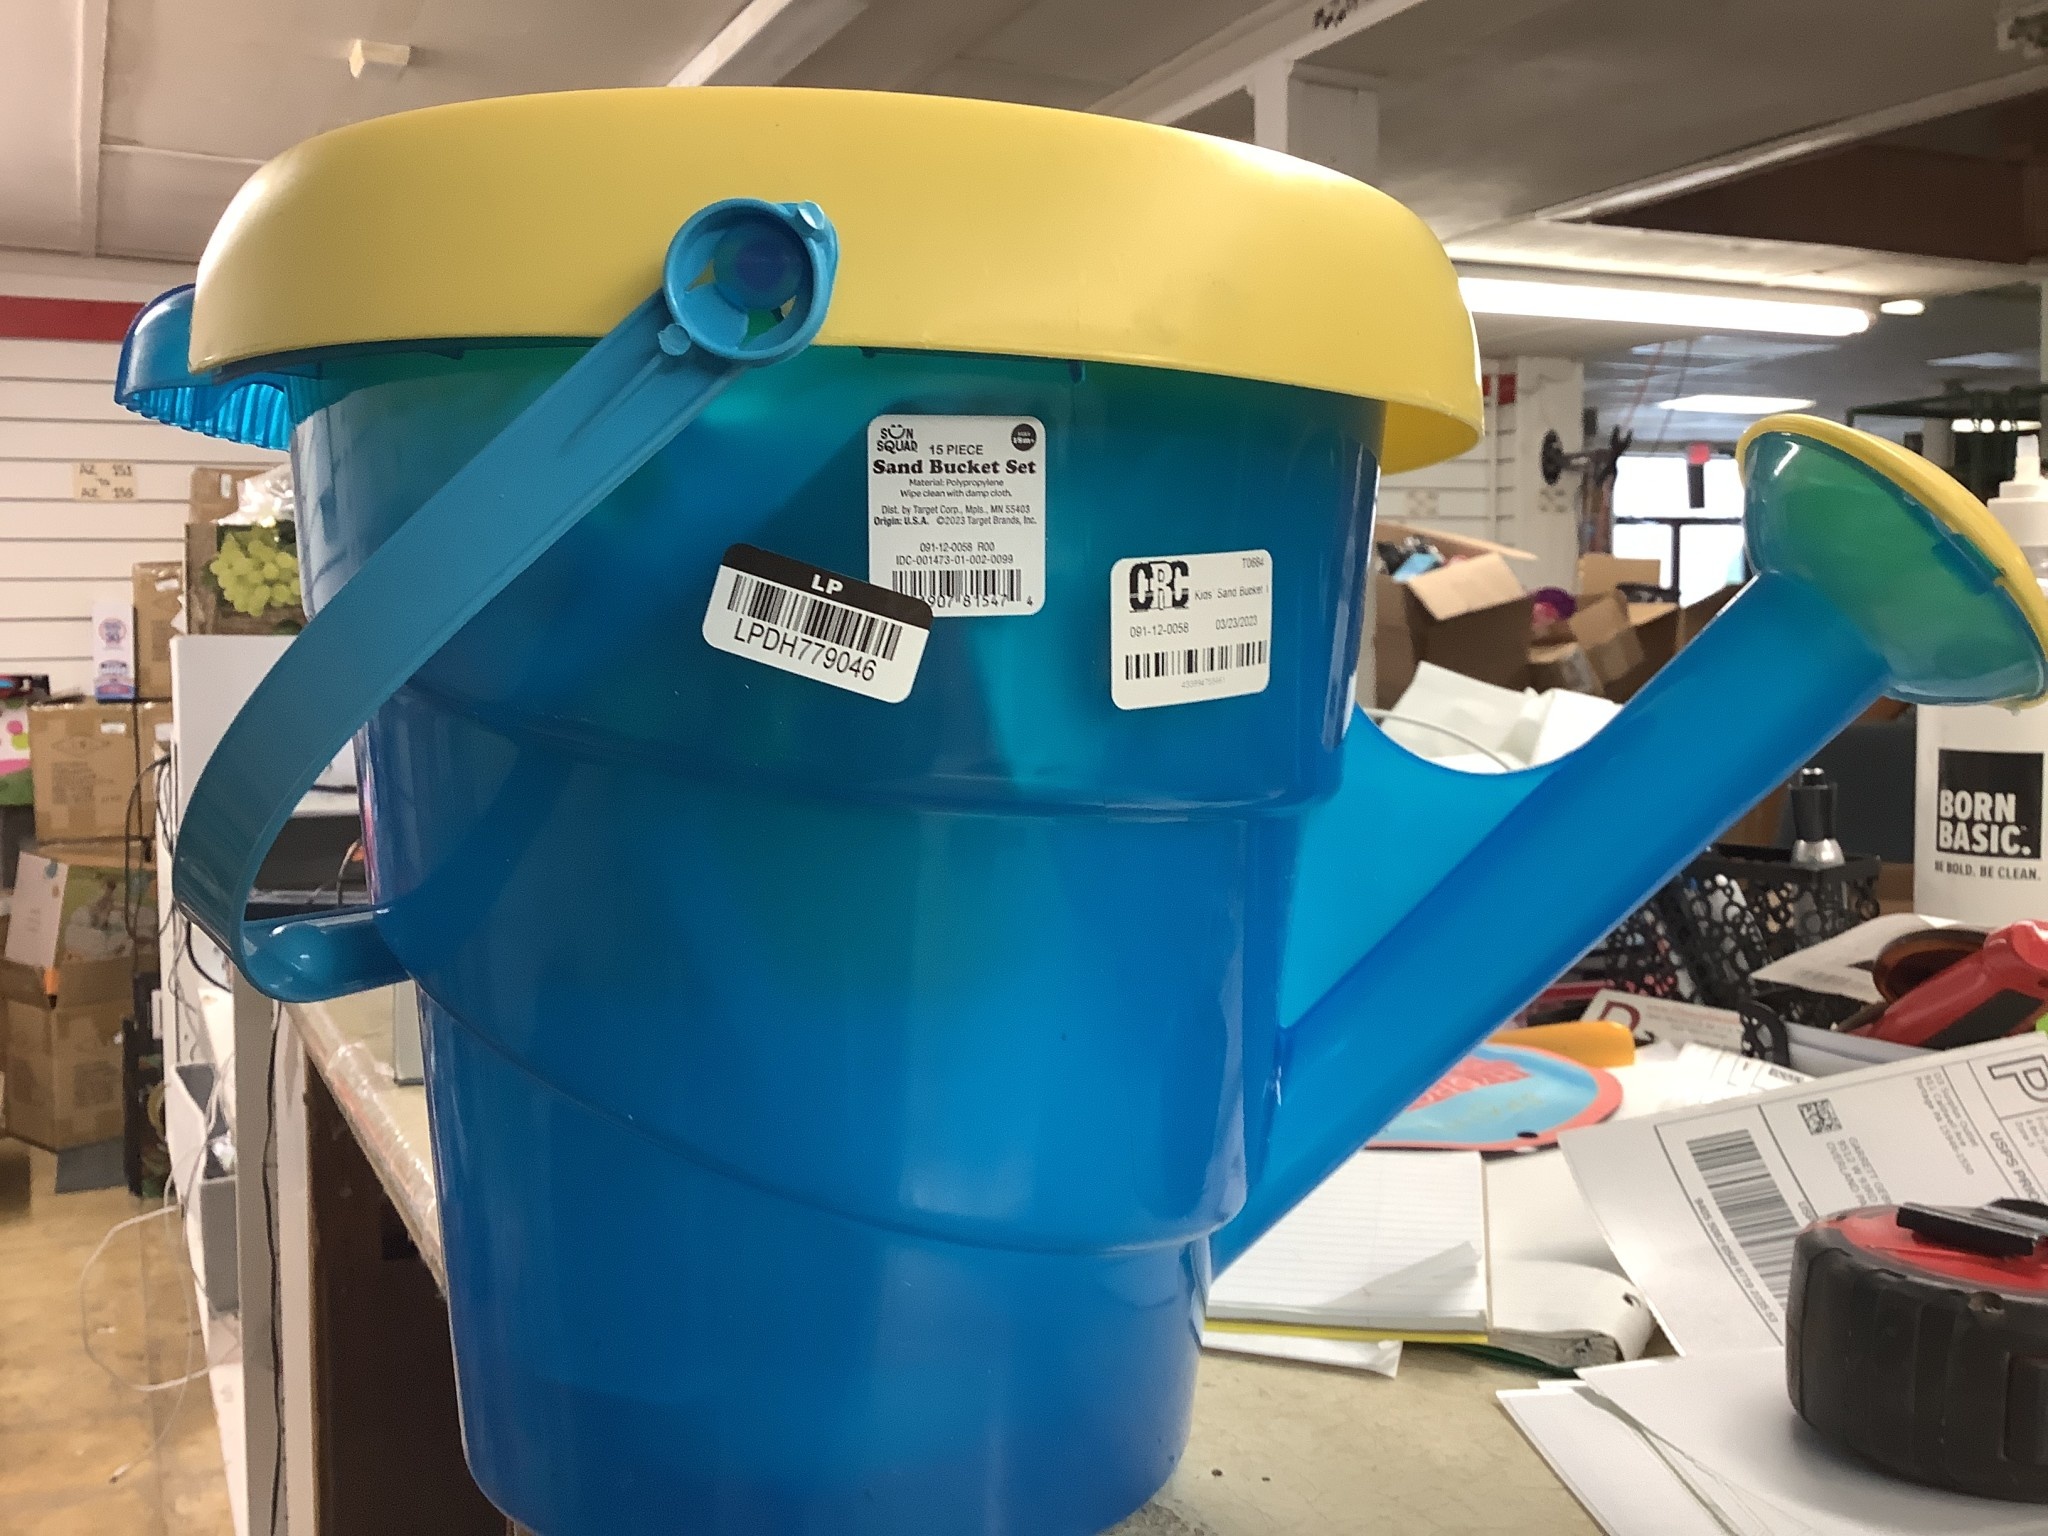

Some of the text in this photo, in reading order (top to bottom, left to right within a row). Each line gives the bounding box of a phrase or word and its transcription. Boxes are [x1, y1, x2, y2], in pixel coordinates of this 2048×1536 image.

[880, 424, 914, 440] SUN
[876, 440, 918, 454] SQUAD
[929, 444, 983, 455] 15 PIECE
[873, 459, 1036, 474] Sand Bucket Set
[908, 478, 1004, 488] Material: Polypropylene
[900, 489, 1012, 499] Wipe clean with damp cloth.
[881, 504, 899, 514] Dist.
[901, 504, 910, 515] by
[913, 504, 938, 515] Target
[990, 504, 1003, 514] MN
[1005, 504, 1031, 514] 55403
[873, 516, 902, 527] Origin:
[903, 515, 930, 525] U.S.A.
[967, 515, 991, 526] Target
[992, 515, 1021, 526] Brands,
[1023, 515, 1038, 525] Inc.
[919, 541, 995, 552] 091-12-0058 R00
[895, 554, 1014, 566] IDC-001473-01-002-0099
[810, 574, 844, 595] LP
[1128, 560, 1190, 613] CRC
[1217, 587, 1237, 599] Sand
[1026, 595, 1034, 607] 4
[1129, 622, 1190, 639] 091-12-0058
[733, 617, 878, 682] LPDH779046
[1939, 789, 2017, 823] BORN
[1946, 861, 1976, 877] BOLD.
[1979, 866, 1995, 878] BE
[1997, 867, 2042, 881] CLEAN.
[1989, 1131, 2019, 1168] USPS
